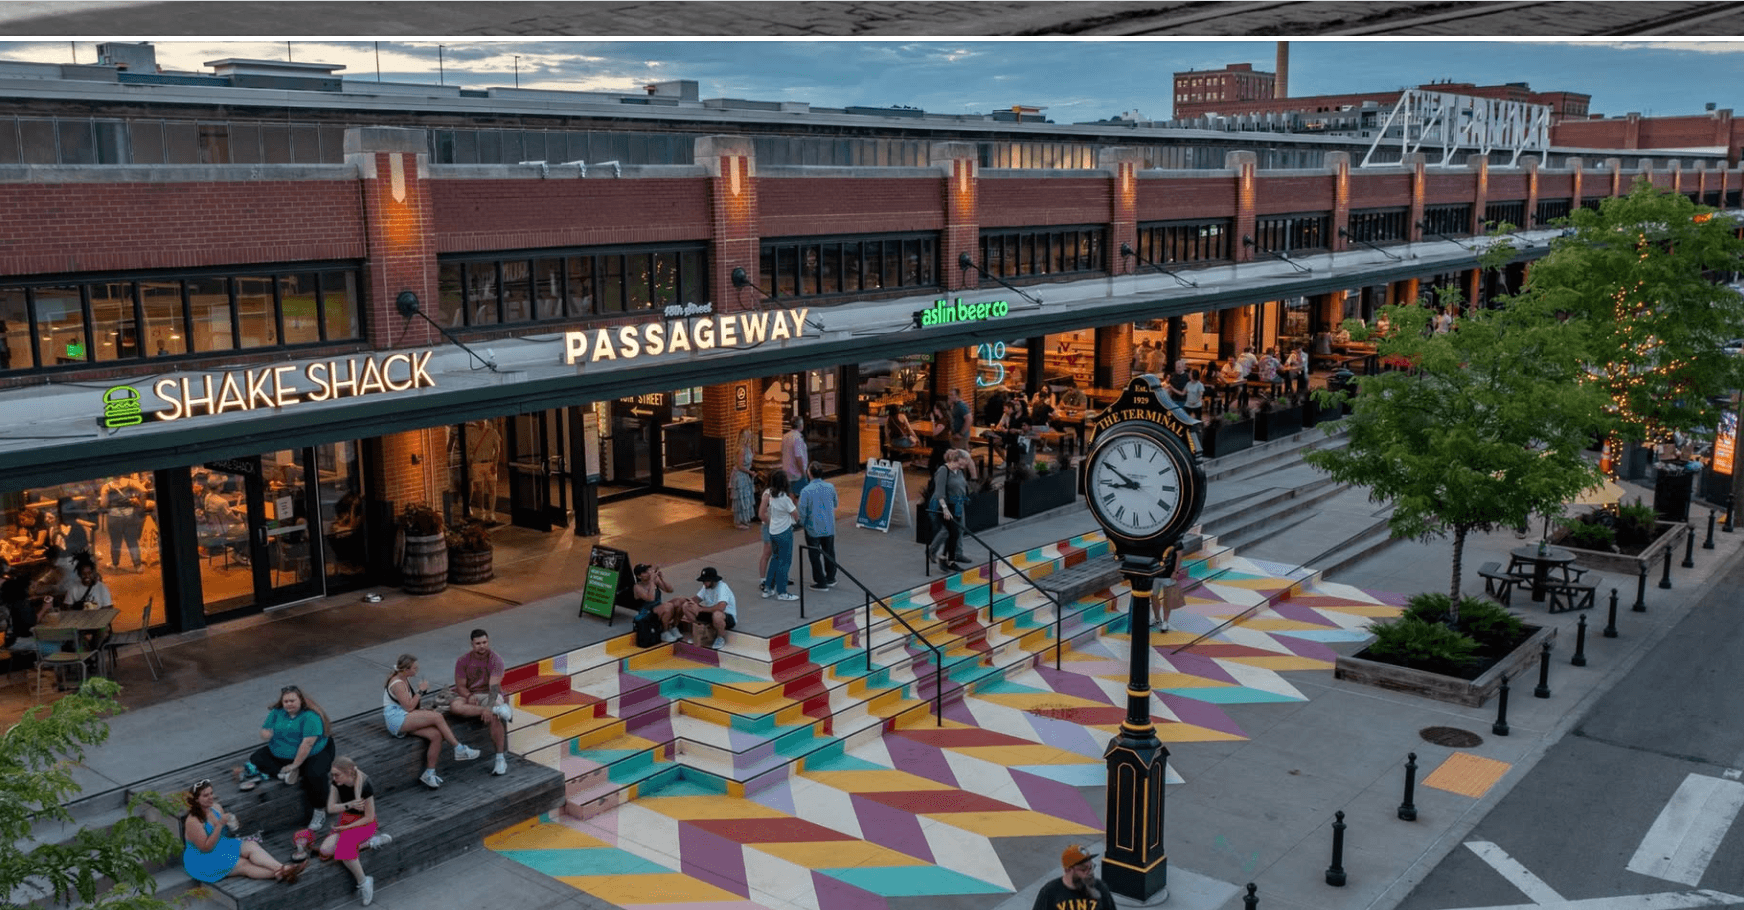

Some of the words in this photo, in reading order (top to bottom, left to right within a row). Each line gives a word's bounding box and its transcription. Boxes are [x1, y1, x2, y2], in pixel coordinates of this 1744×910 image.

[922, 300, 957, 325] aslin
[565, 308, 809, 365] PASSAGEWAY
[155, 366, 300, 421] SHAKE
[306, 351, 437, 402] SHACK
[638, 393, 664, 406] STREET
[1100, 412, 1121, 430] THE
[1121, 409, 1184, 437] TERMINAL
